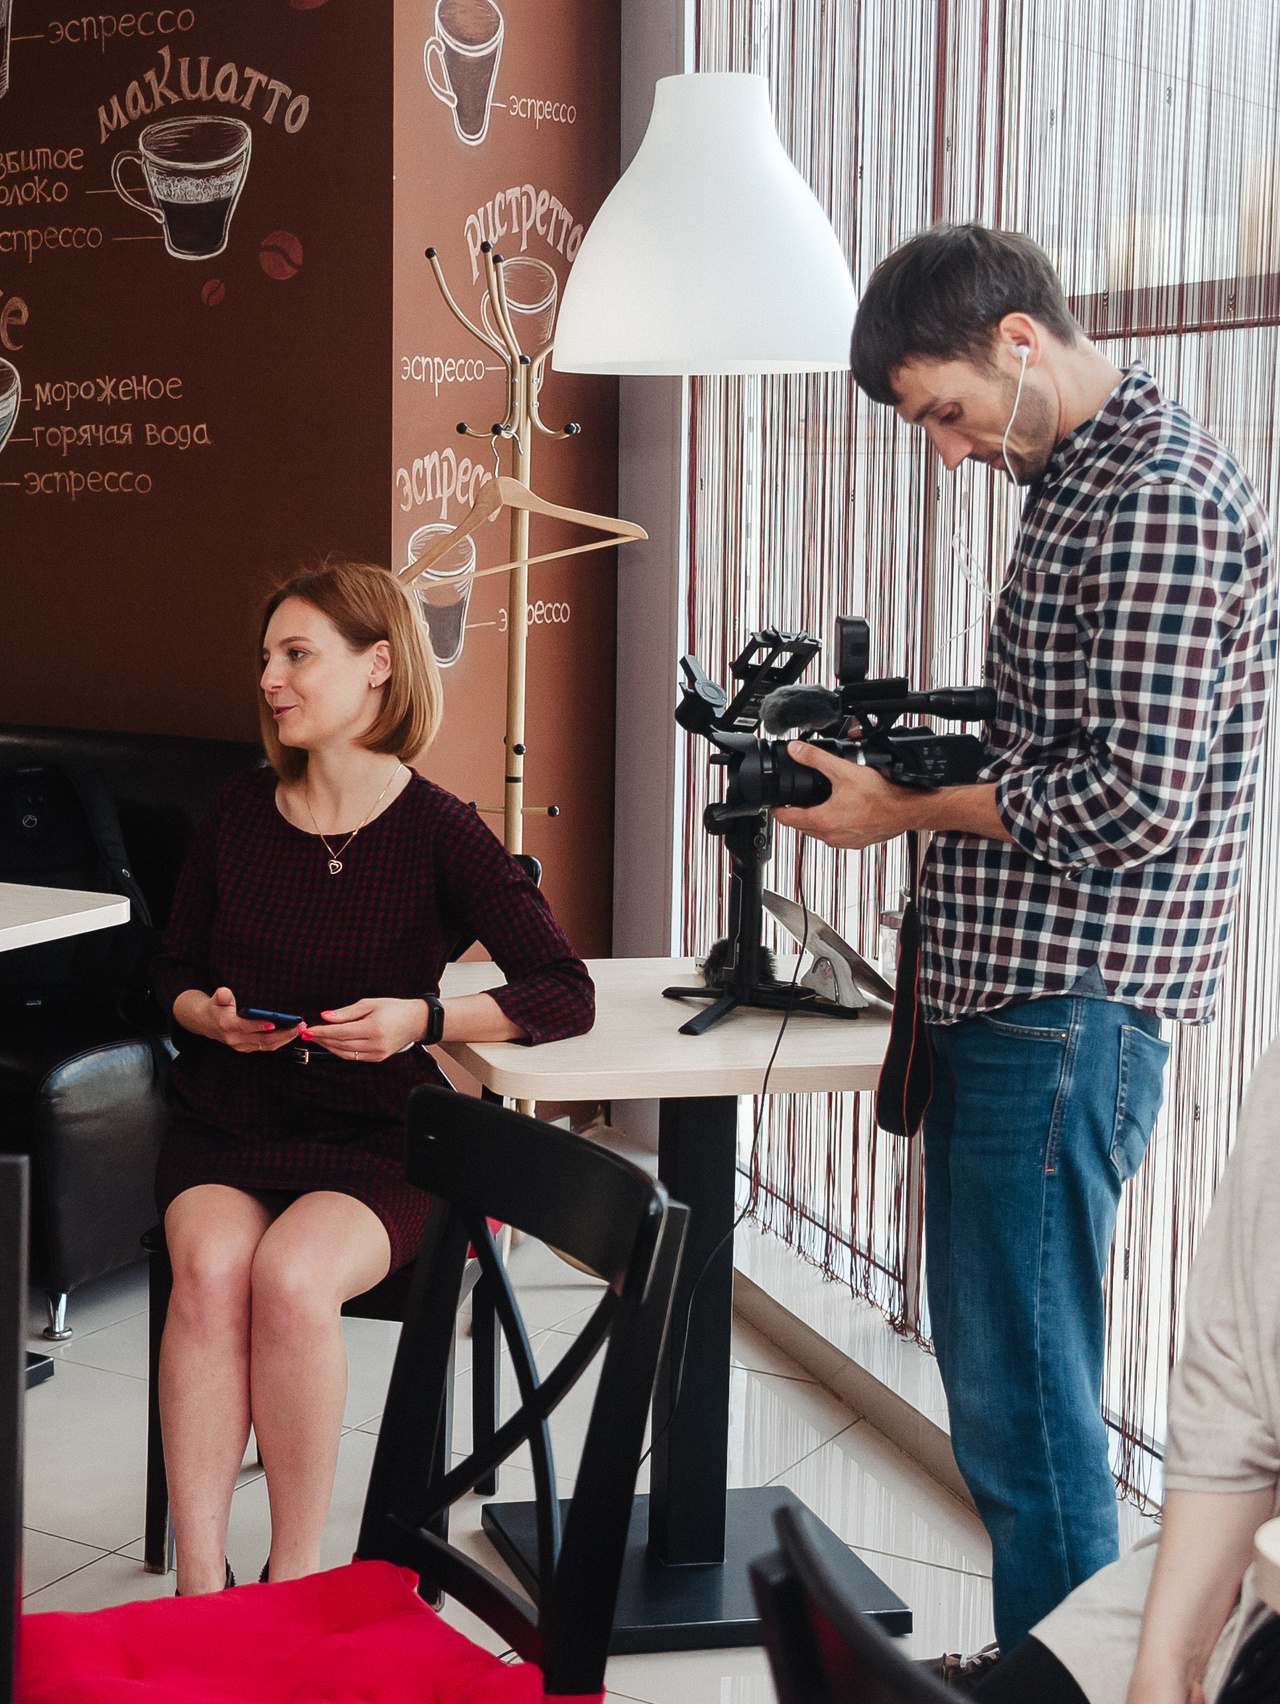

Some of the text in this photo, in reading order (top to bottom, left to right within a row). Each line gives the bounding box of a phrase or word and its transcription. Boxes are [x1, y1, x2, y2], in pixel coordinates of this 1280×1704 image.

[48, 8, 196, 53] эспрессо
[509, 95, 577, 130] эспрессо
[34, 374, 184, 411] мороженое
[400, 356, 486, 397] эспрессо
[32, 423, 212, 457] горячая вода
[24, 469, 153, 501] эспрессо
[396, 447, 502, 523] эспрес
[498, 600, 571, 638] эрессо
